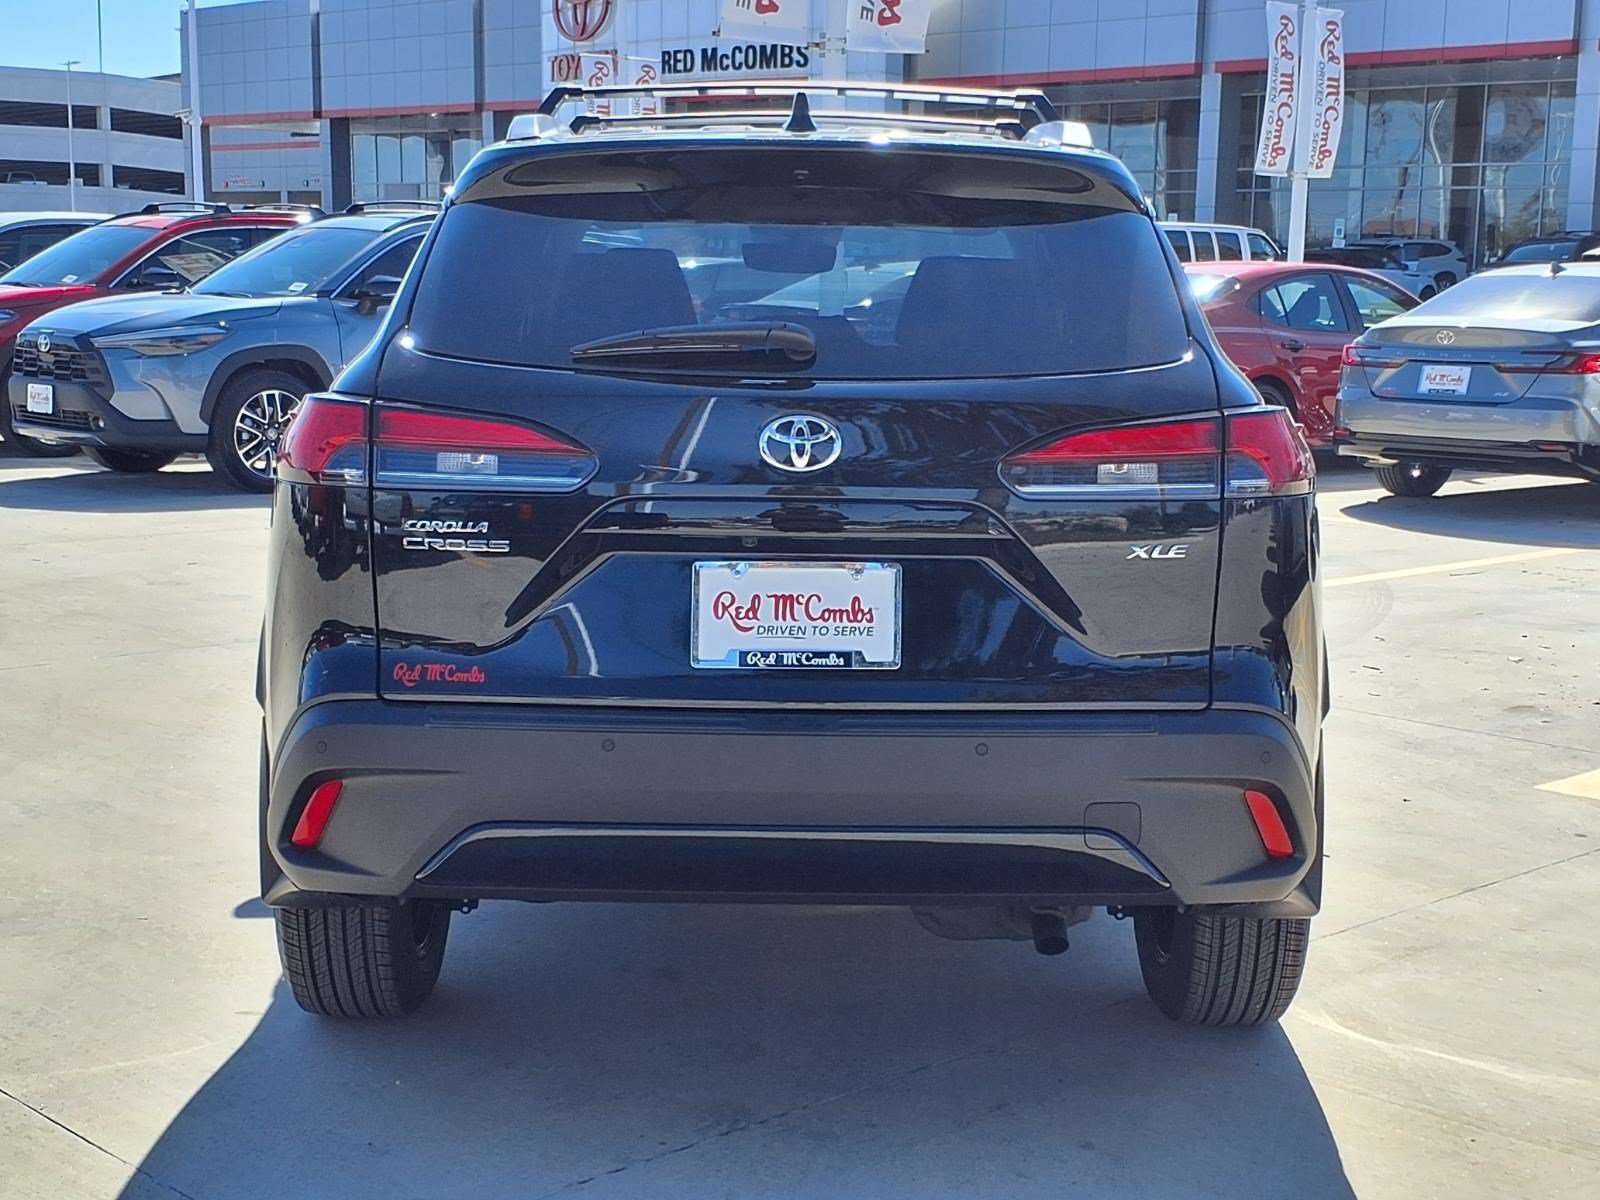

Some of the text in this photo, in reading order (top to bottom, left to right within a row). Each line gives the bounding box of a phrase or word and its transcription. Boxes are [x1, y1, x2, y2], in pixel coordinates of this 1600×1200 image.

[661, 44, 809, 75] RED McCOMBS
[588, 61, 610, 87] Re
[1267, 15, 1295, 168] Red McCombs
[1315, 20, 1342, 170] Red McCombs
[1260, 57, 1278, 166] DRIVEN TO SERVE
[1308, 61, 1325, 166] DRIVEN TO SERVE
[403, 520, 488, 533] COROLLA
[403, 537, 510, 552] CROSS
[1125, 544, 1189, 559] XLE
[712, 591, 874, 633] Red McCombs
[756, 625, 875, 637] DRIVEN TO SERVE
[747, 651, 845, 666] Red McCombs
[393, 662, 485, 687] Red McCombs
